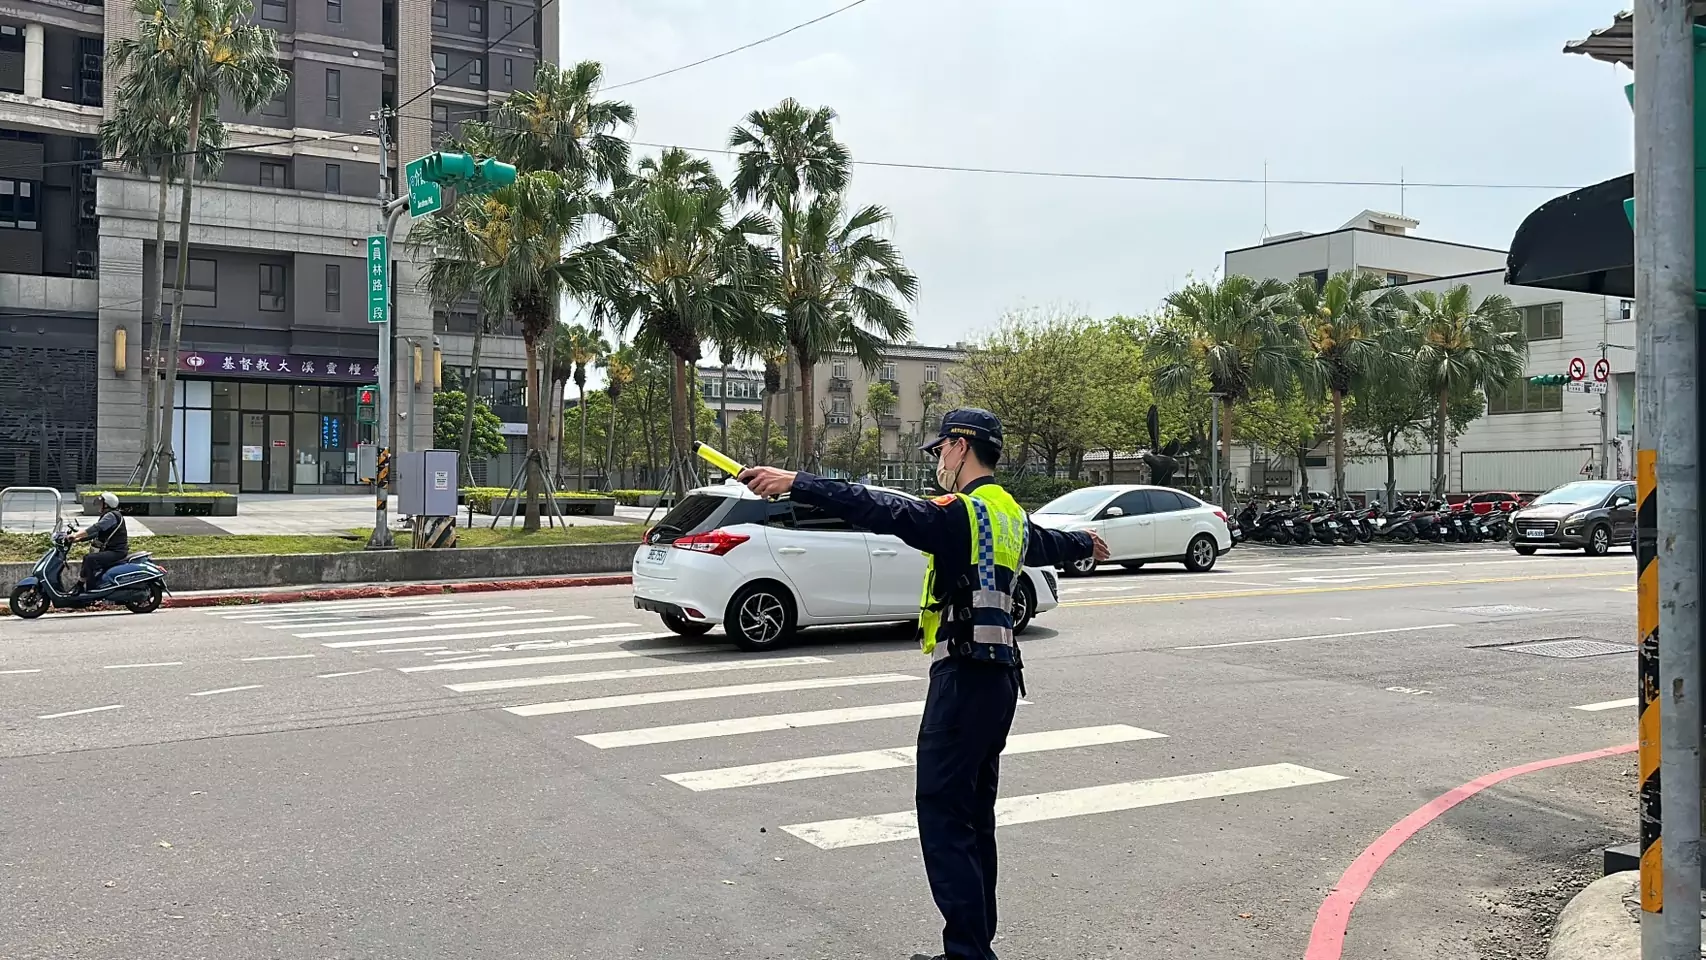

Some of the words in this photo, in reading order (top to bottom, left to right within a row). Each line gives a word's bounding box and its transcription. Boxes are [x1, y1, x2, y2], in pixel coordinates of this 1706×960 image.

[372, 247, 384, 320] 員林路一段
